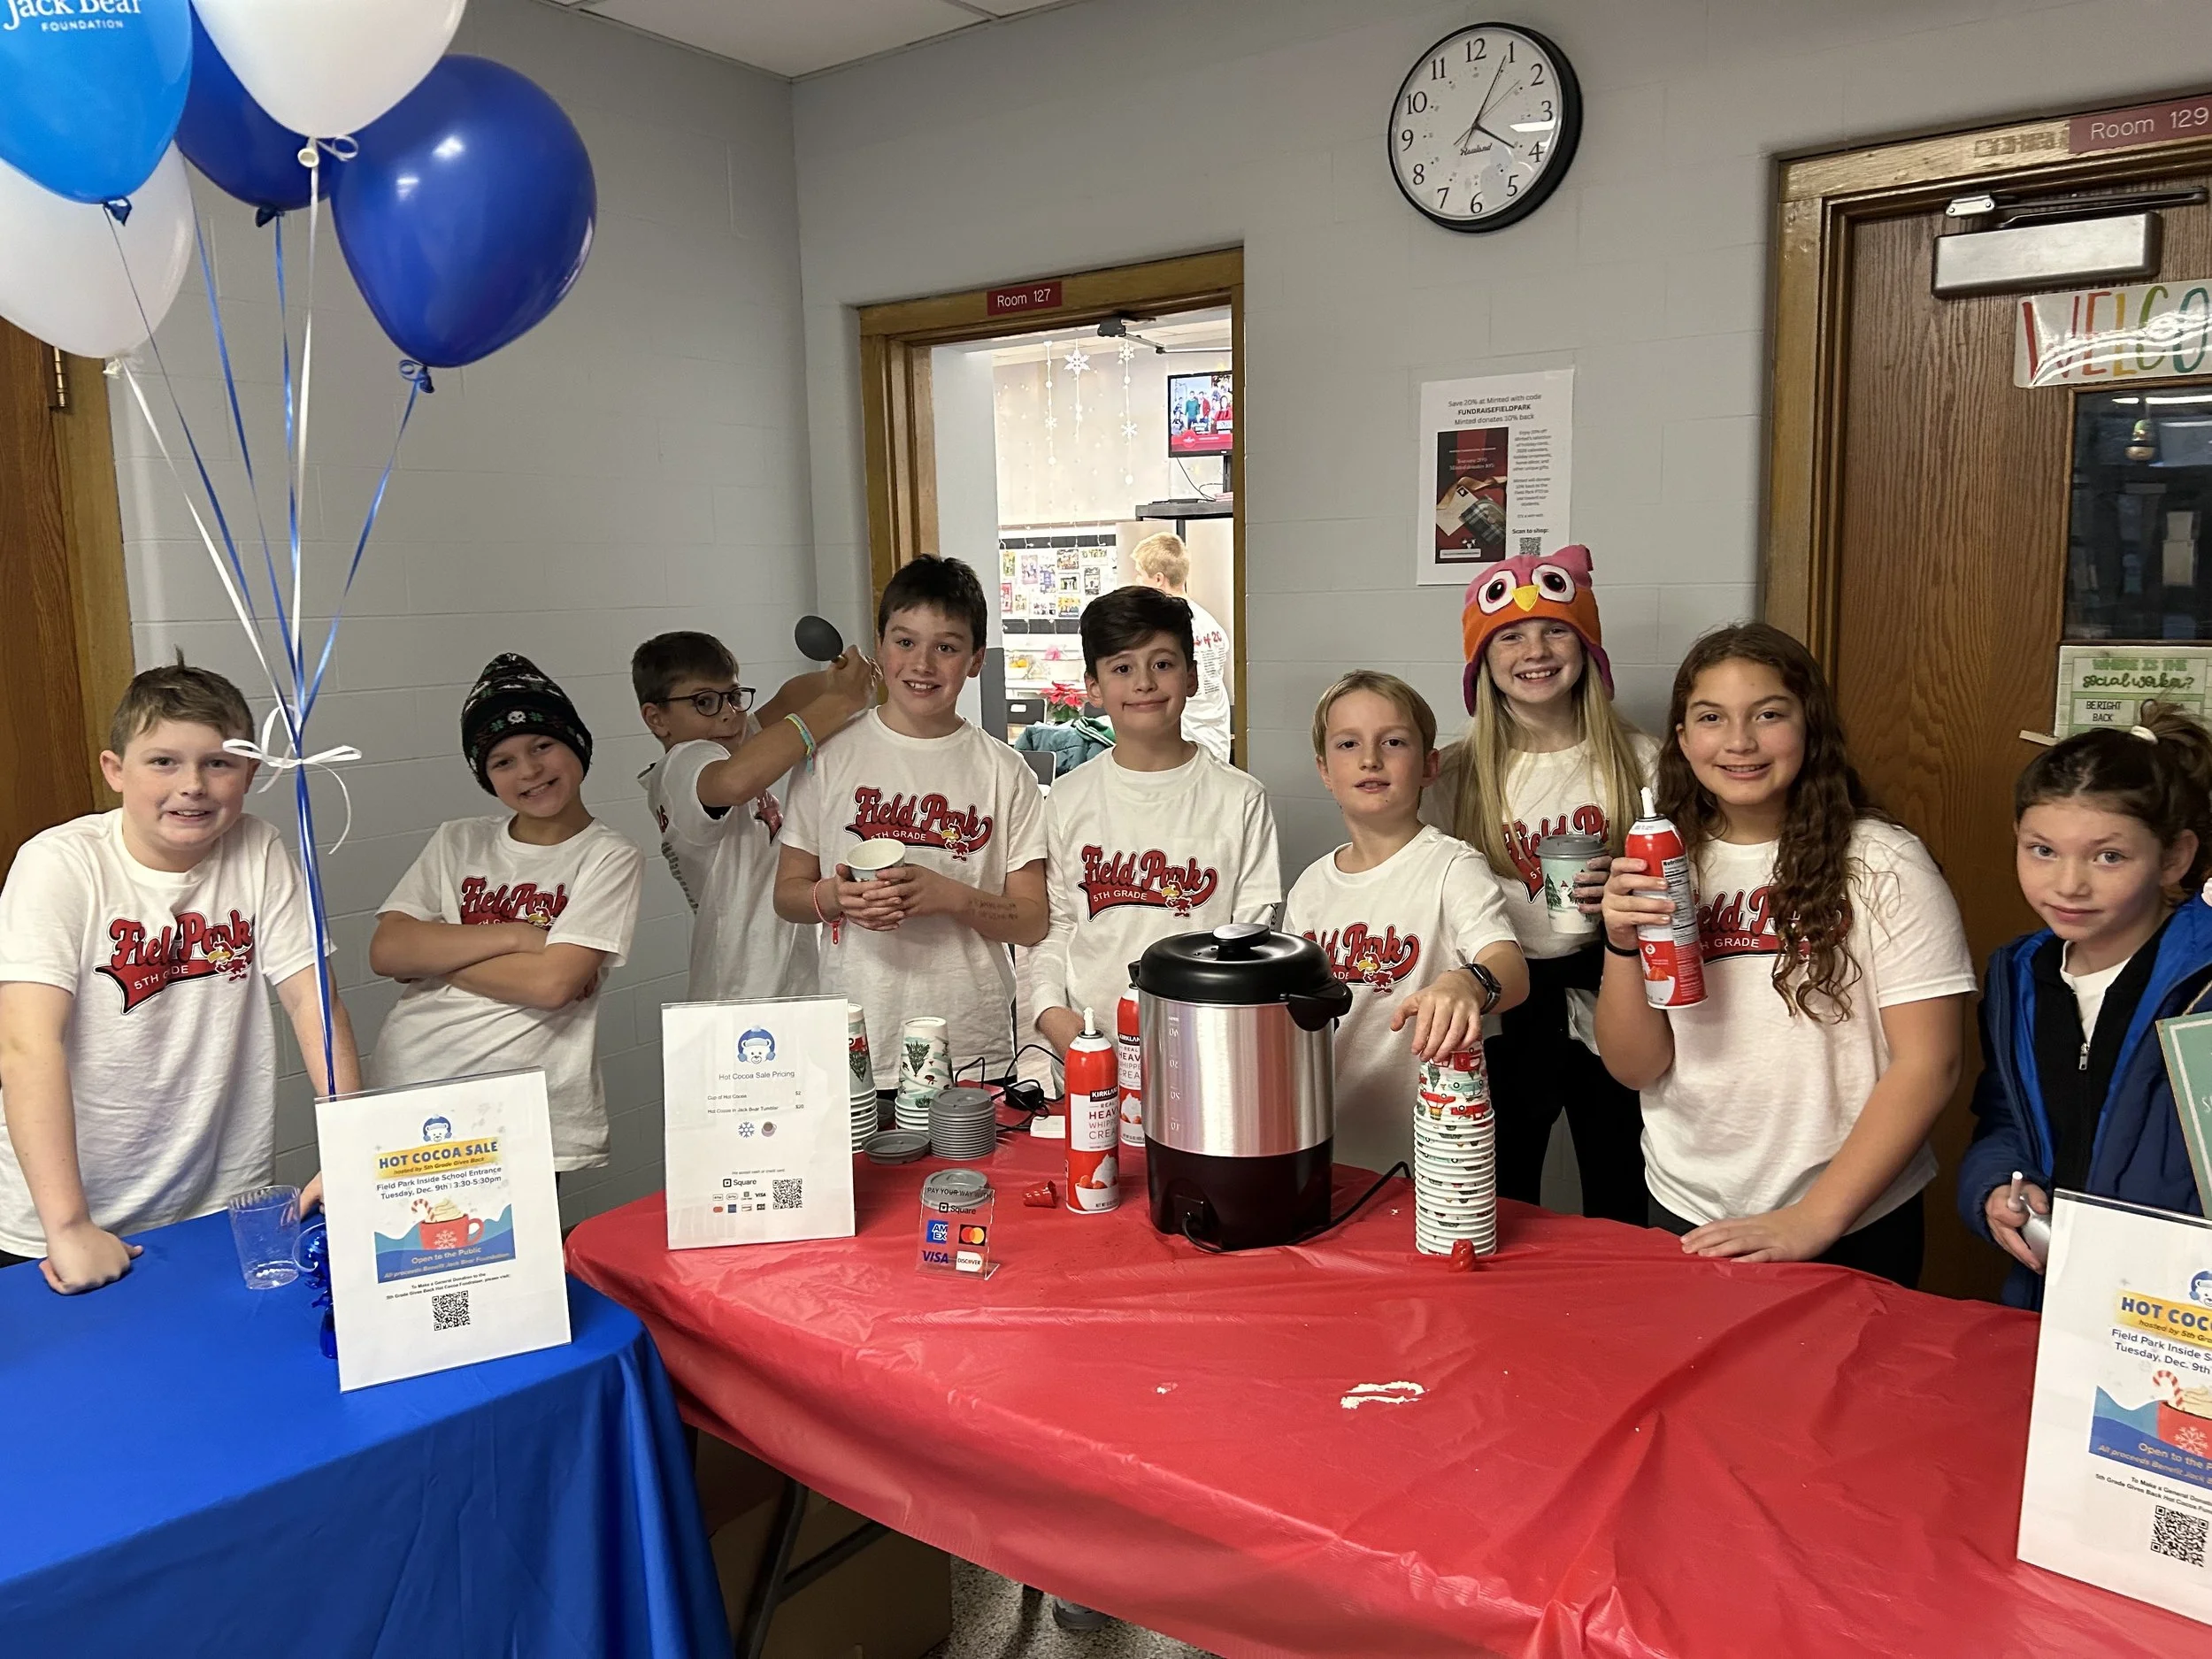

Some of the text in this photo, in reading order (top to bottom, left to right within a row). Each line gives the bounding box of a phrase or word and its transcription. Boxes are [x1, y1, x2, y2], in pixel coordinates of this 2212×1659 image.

[41, 19, 124, 32] FOUNDATION
[1464, 38, 1486, 63] 12
[1507, 41, 1516, 64] 1
[1430, 57, 1446, 81] 11
[1530, 63, 1544, 87] 2
[1407, 91, 1427, 115] 10
[1540, 100, 1553, 122] 3
[2091, 107, 2209, 141] Room 129
[1402, 129, 1414, 151] 9
[1528, 141, 1544, 163] 4
[1412, 163, 1425, 185] 8
[1506, 174, 1519, 197] 5
[1437, 187, 1449, 210] 7
[1470, 191, 1483, 214] 6
[997, 288, 1051, 308] Room 127
[1458, 404, 1532, 415] FUNDRAISEFIELDPARK
[2083, 672, 2131, 687] social
[2086, 701, 2122, 710] BE RIGHT
[2093, 713, 2113, 722] BACK
[855, 787, 979, 836] Field Park
[893, 831, 927, 841] GRADE
[1081, 845, 1202, 892] Field Park
[1094, 890, 1148, 902] 5TH GRADE
[176, 909, 253, 962] Park
[1343, 923, 1402, 970] Park
[1714, 937, 1761, 949] GRADE
[134, 973, 159, 990] 5TH
[379, 1141, 498, 1169] HOT COCOA SALE
[377, 1182, 396, 1191] Field
[417, 1176, 440, 1185] Inside
[442, 1171, 467, 1181] School
[469, 1167, 502, 1176] Entrance
[381, 1189, 415, 1200] Tuesday,
[454, 1176, 502, 1188] 3:30-5:30pm
[950, 1205, 976, 1215] Square
[411, 1256, 434, 1264] Open
[458, 1247, 481, 1256] Public
[922, 1250, 949, 1263] VISA
[2122, 1297, 2212, 1332] HOT COC
[2139, 1320, 2168, 1332] hosted
[2169, 1327, 2180, 1336] by
[2181, 1330, 2195, 1339] 5th
[2111, 1329, 2138, 1342] Field
[2141, 1336, 2165, 1349] Park
[2168, 1343, 2200, 1359] Inside
[2115, 1342, 2210, 1374] Tuesday, Dec. 9th
[2139, 1442, 2203, 1469] Open to the
[2107, 1477, 2125, 1486] Grade
[2126, 1483, 2145, 1493] Gives
[2146, 1489, 2162, 1498] Back
[2140, 1479, 2156, 1489] Make
[2163, 1486, 2188, 1498] General
